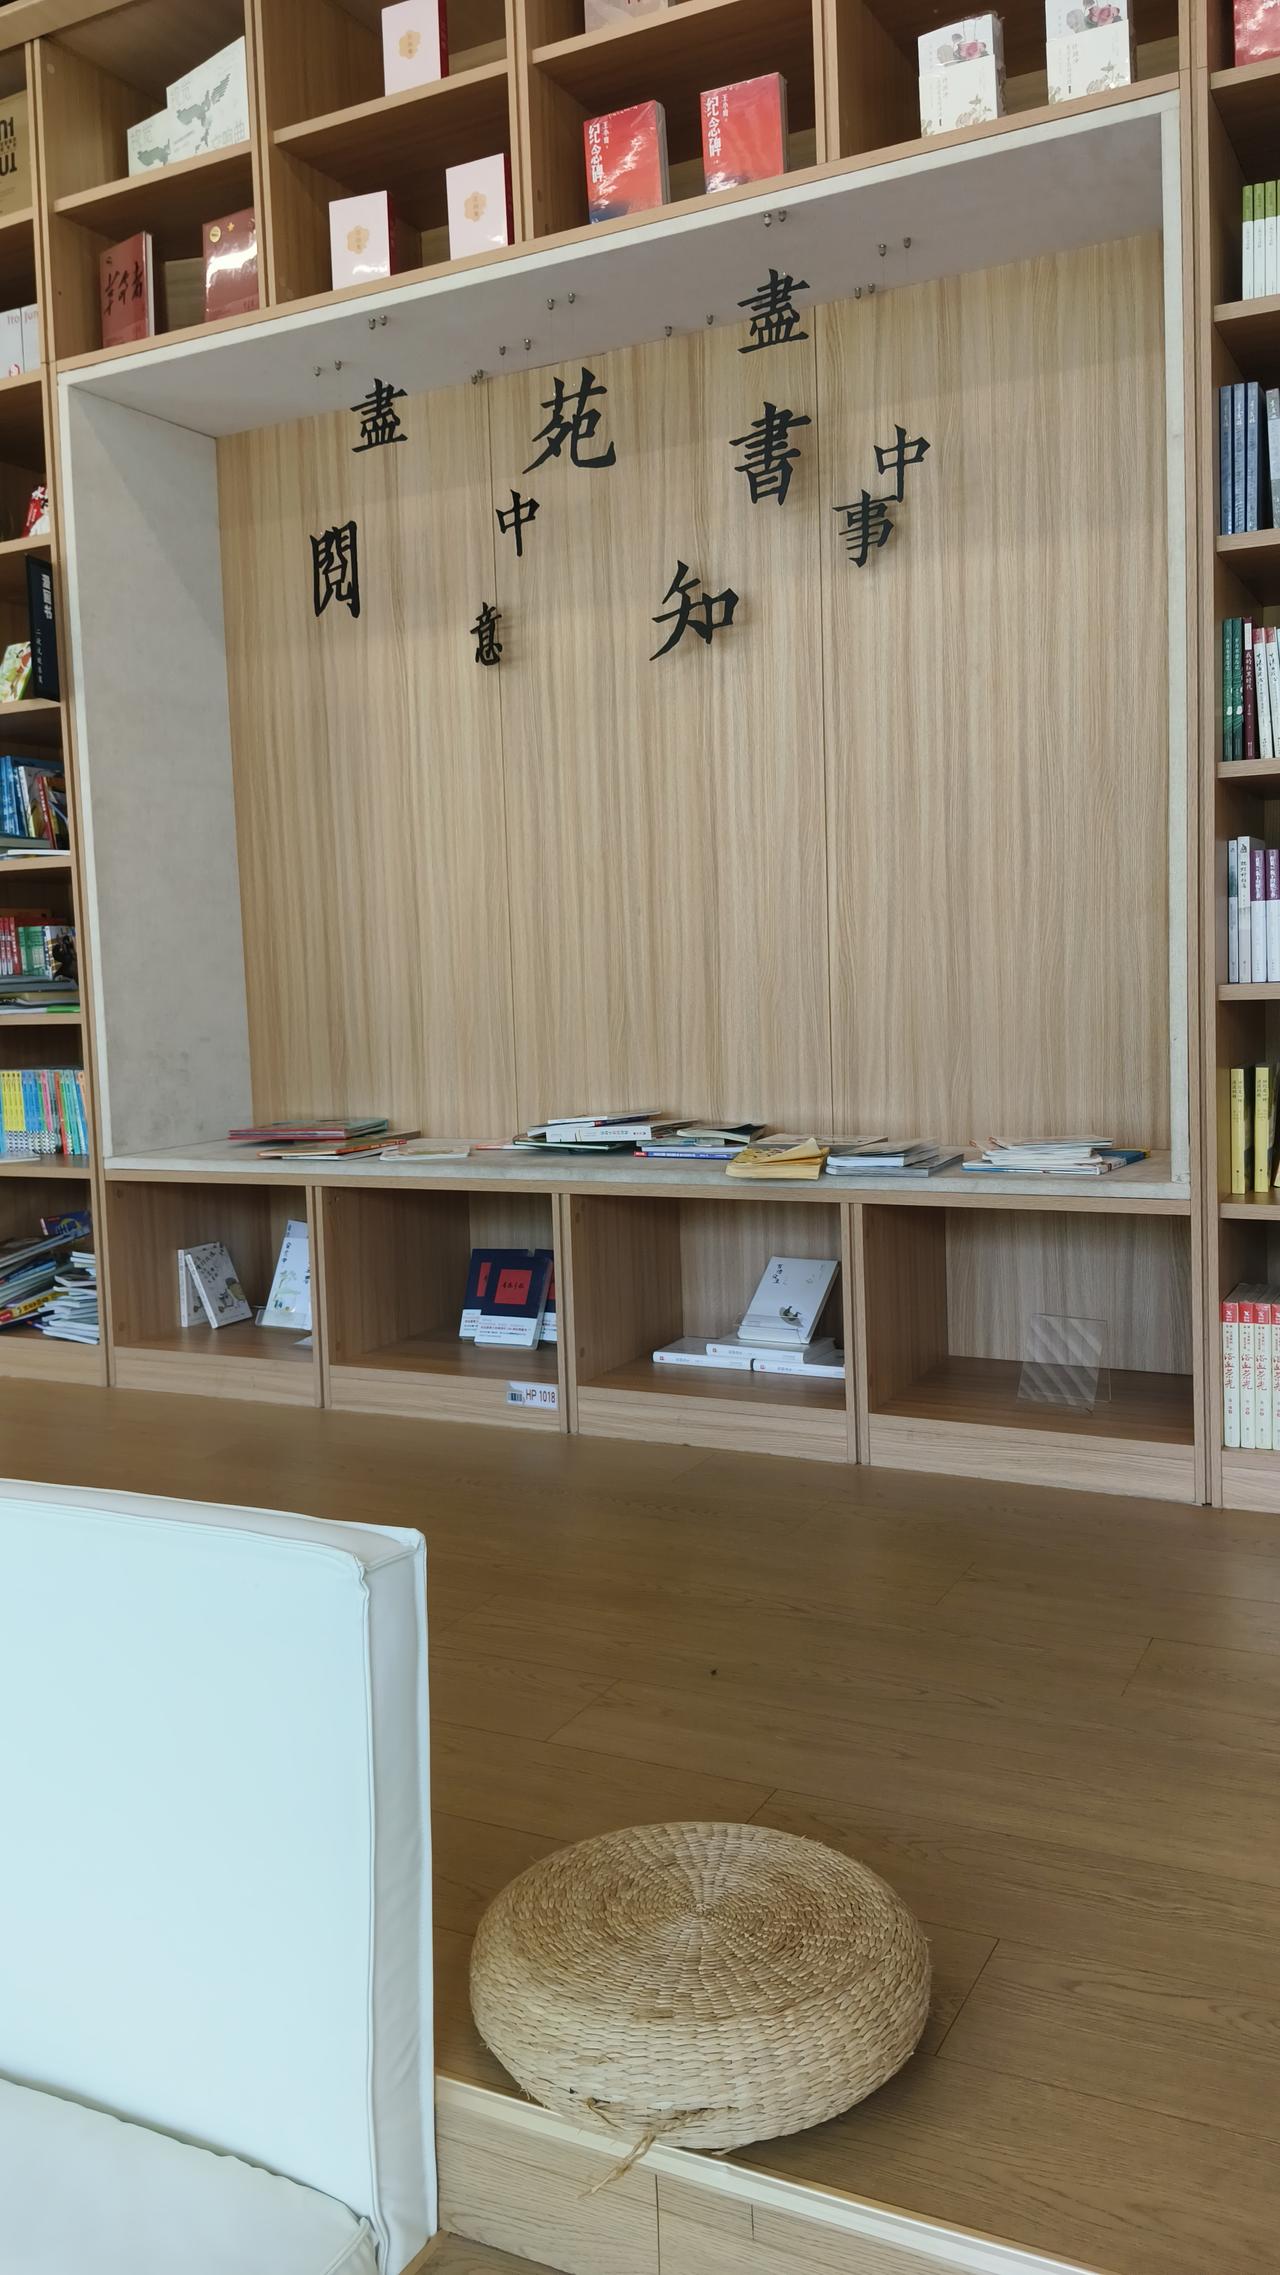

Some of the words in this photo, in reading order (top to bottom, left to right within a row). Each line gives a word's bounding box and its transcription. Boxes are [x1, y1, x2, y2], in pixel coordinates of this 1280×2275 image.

[588, 122, 605, 184] 纪念碑
[705, 95, 722, 158] 纪念碑
[738, 269, 810, 353] 盡
[351, 379, 407, 452] 盡
[523, 367, 616, 474] 苑
[729, 402, 811, 505] 書
[874, 425, 930, 503] 中
[496, 490, 539, 557] 中
[833, 490, 896, 568] 事
[310, 521, 360, 618] 閱
[470, 602, 502, 666] 意
[650, 560, 739, 660] 知
[526, 1388, 537, 1401] HP
[539, 1390, 556, 1404] 1018
